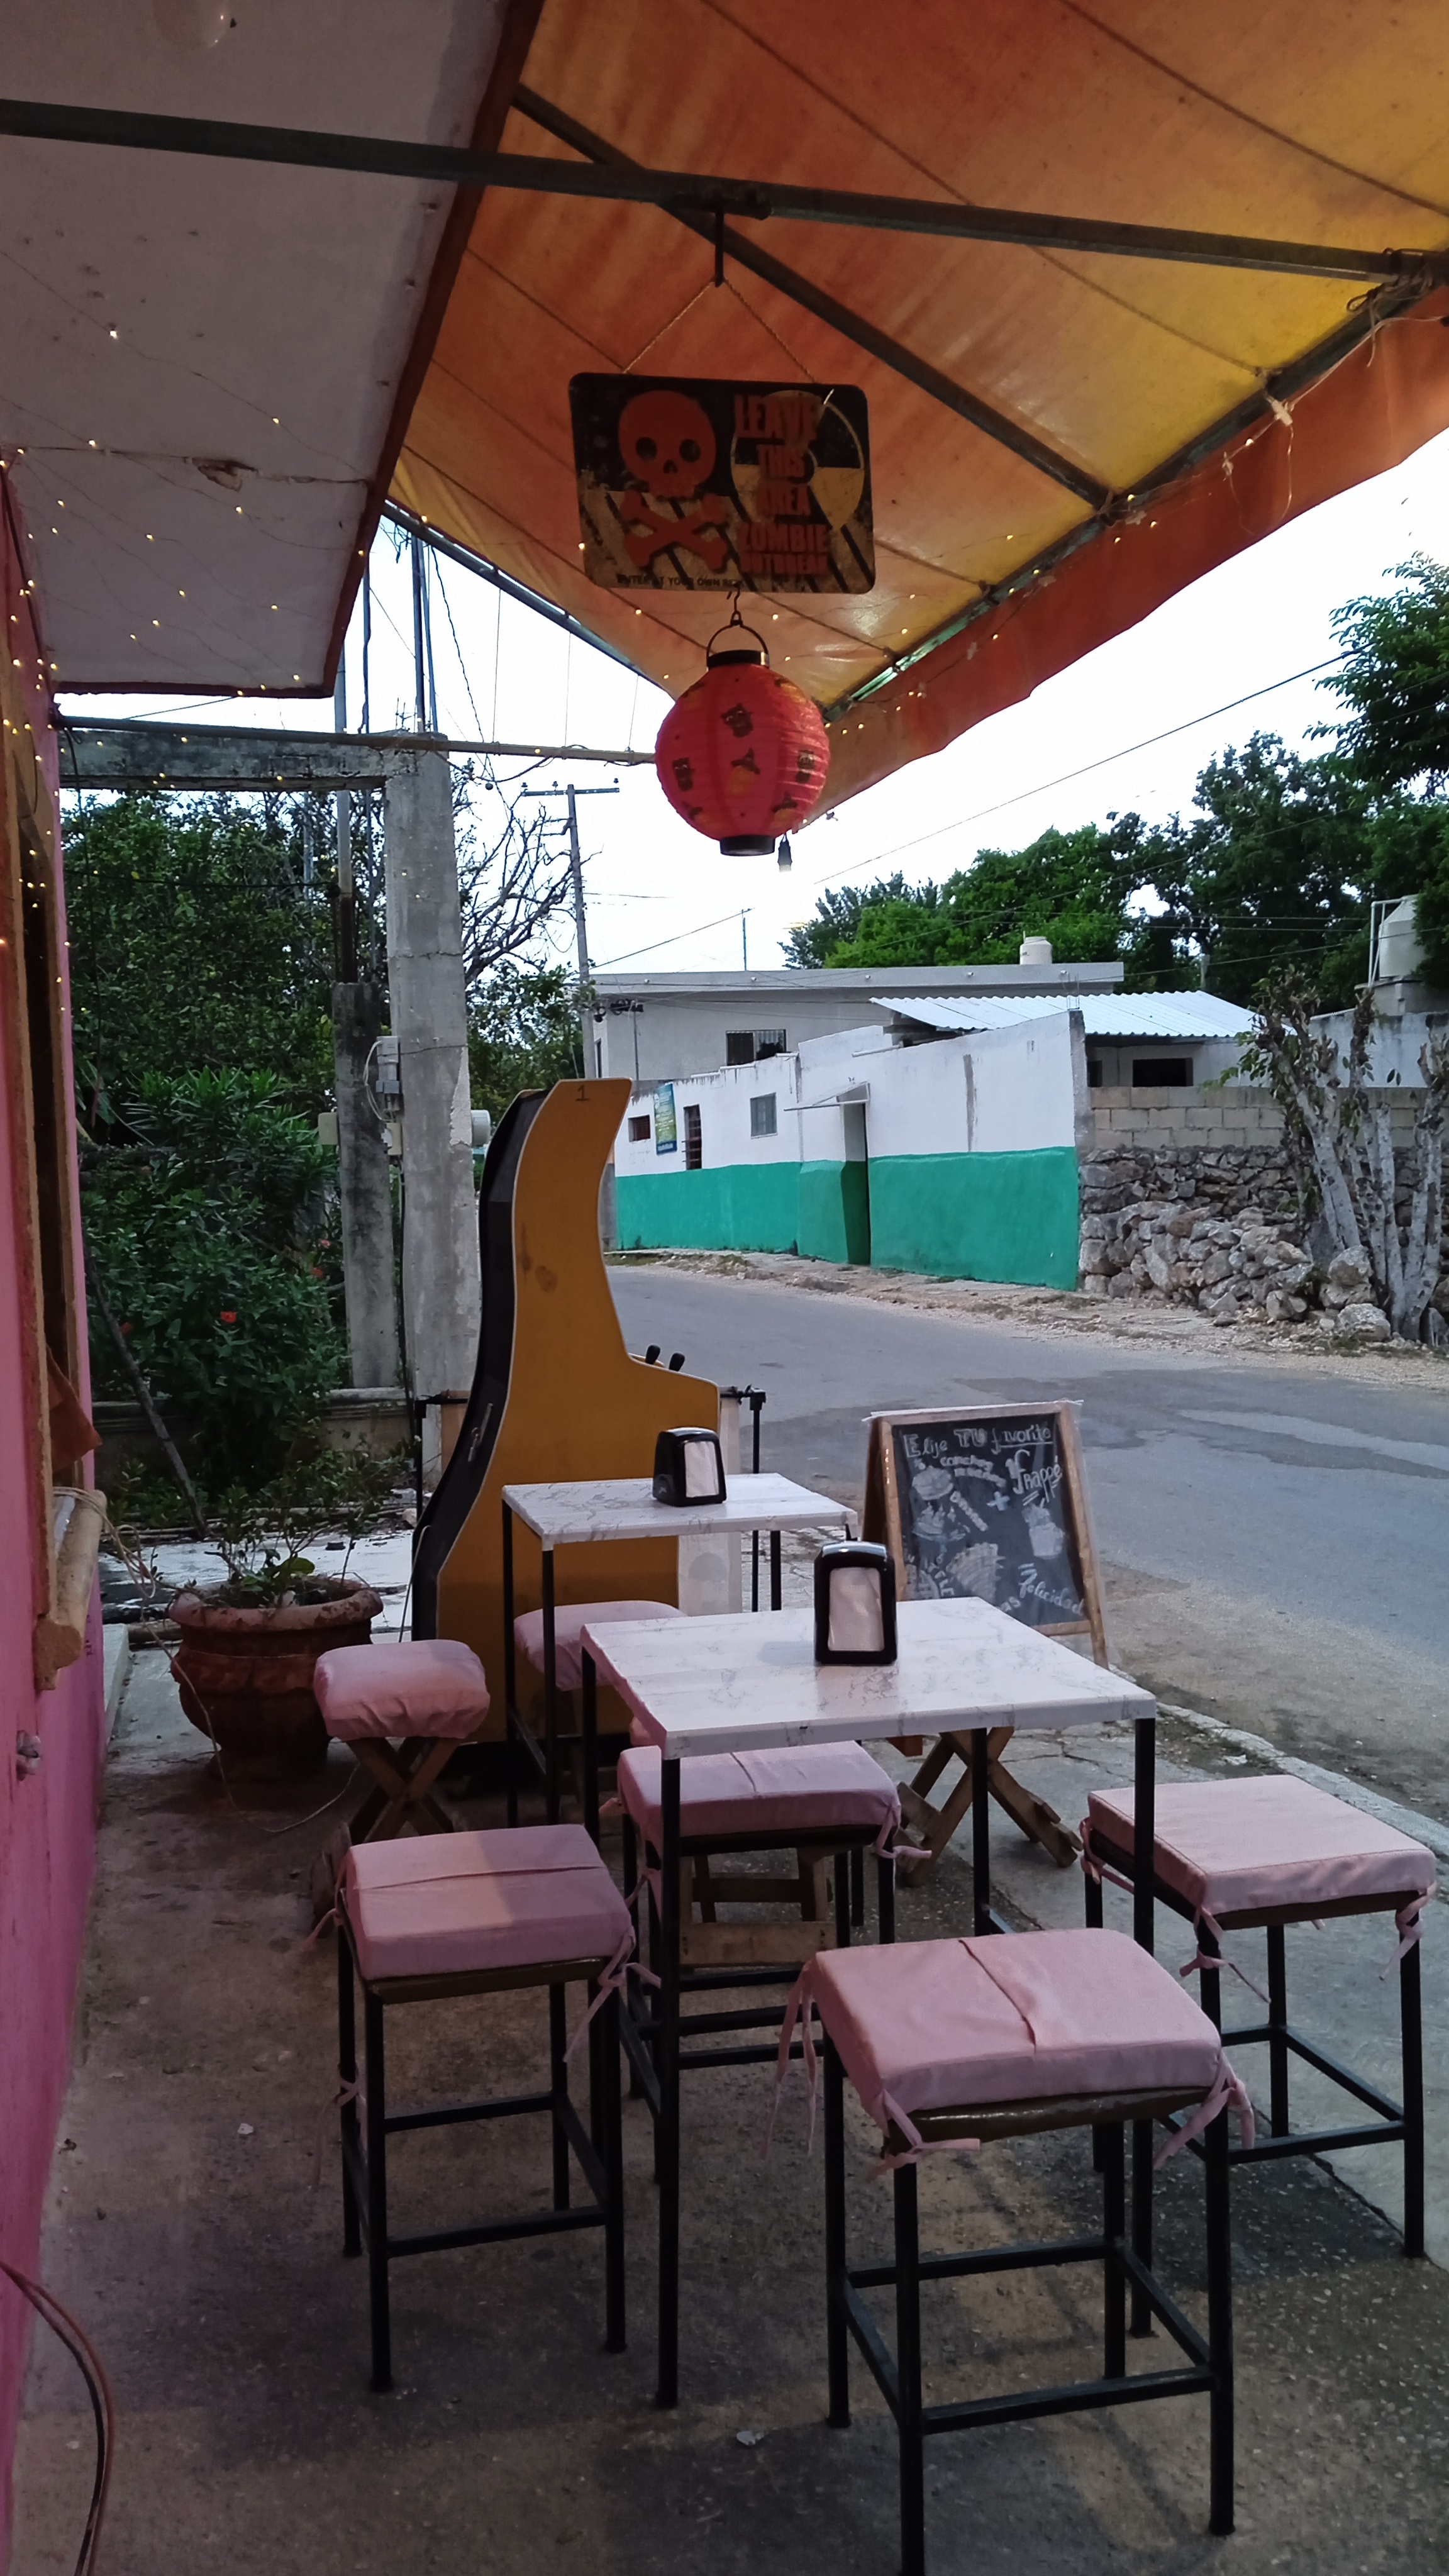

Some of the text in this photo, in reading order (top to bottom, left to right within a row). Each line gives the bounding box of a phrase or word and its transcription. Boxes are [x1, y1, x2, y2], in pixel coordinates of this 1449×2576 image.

[735, 394, 816, 442] LEAVE
[757, 445, 805, 478] THIS
[755, 484, 811, 517] AREA
[738, 523, 829, 552] ZOMBIE
[740, 552, 828, 574] OUTBREAK
[667, 576, 694, 587] YOR
[697, 577, 721, 587] OWN
[575, 1084, 589, 1101] 1
[903, 1434, 948, 1458] Elije
[953, 1428, 988, 1448] TU
